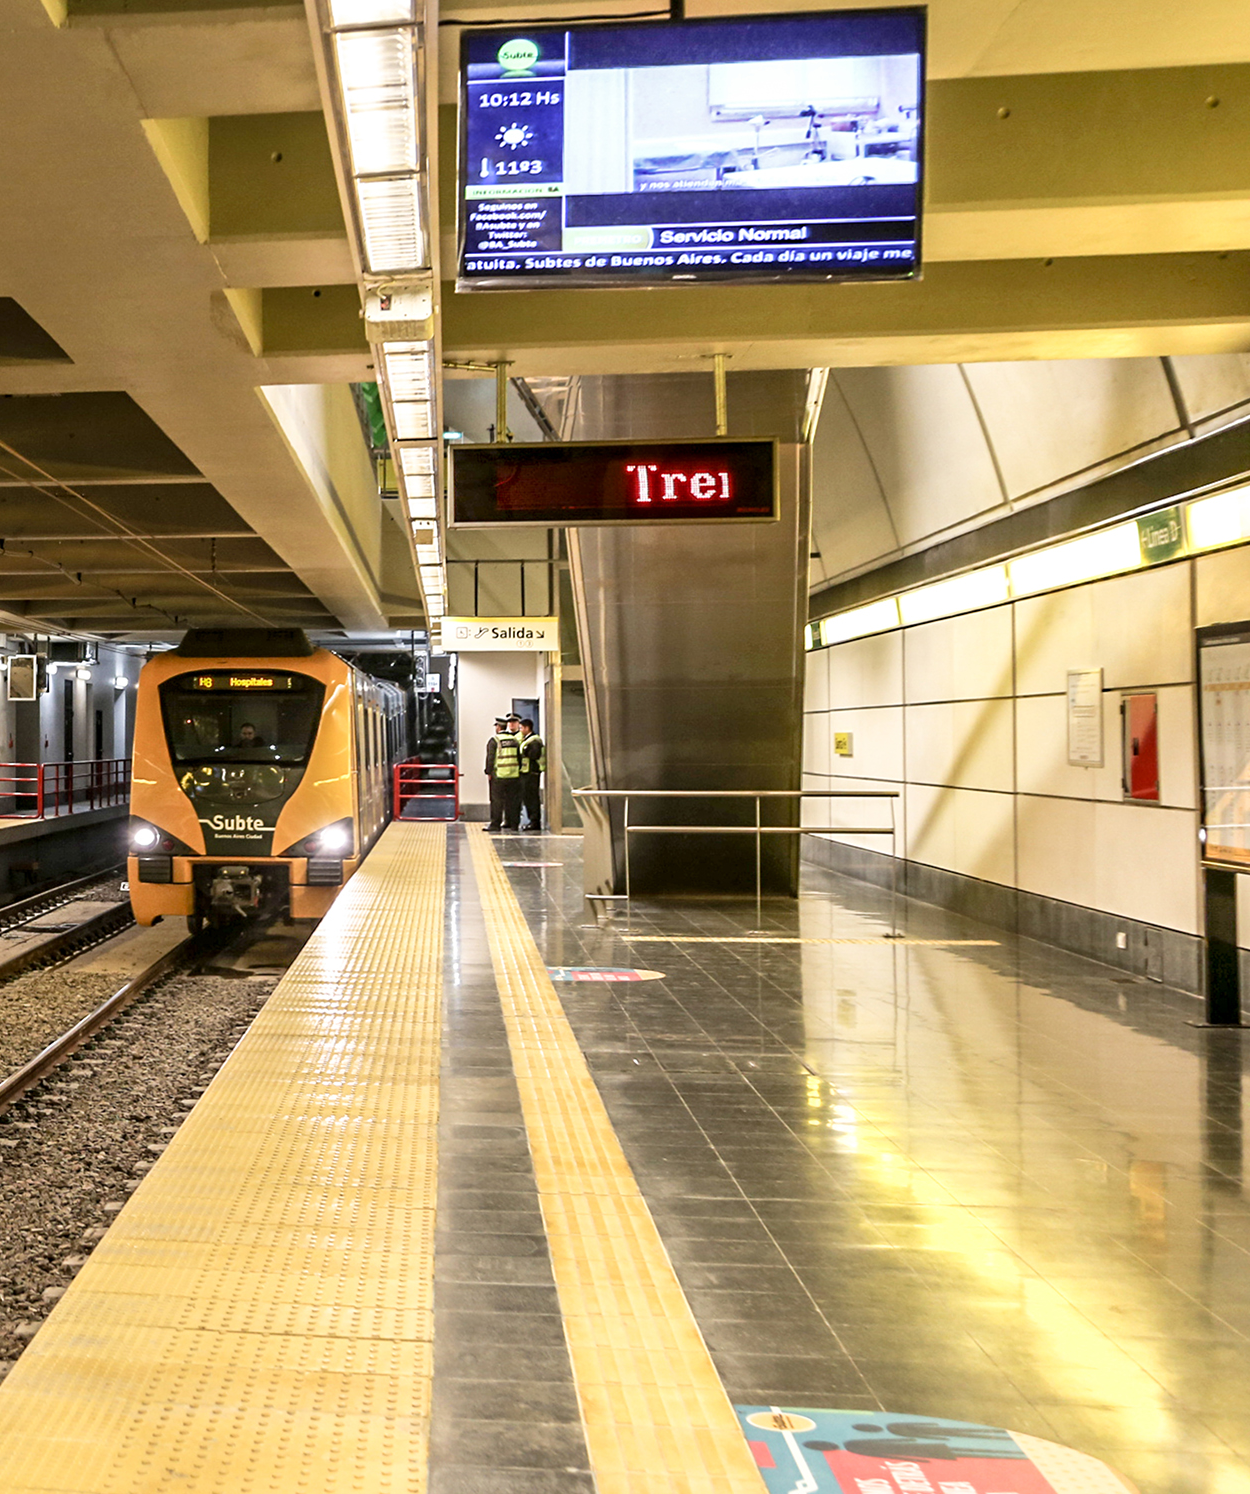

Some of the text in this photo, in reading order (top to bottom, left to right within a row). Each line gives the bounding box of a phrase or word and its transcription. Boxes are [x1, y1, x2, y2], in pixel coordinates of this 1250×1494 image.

[479, 91, 560, 108] 10:12 Hs
[470, 210, 547, 221] Facebook.com/
[518, 222, 526, 230] y
[659, 226, 807, 244] Servicio Normal
[525, 256, 581, 270] Subtes
[585, 256, 607, 268] de
[610, 254, 674, 267] Buenos
[677, 252, 727, 265] Aires.
[730, 251, 775, 264] Cada
[778, 248, 805, 262] día
[809, 250, 833, 262] un
[837, 248, 879, 263] viaje
[492, 627, 533, 639] Salida
[230, 677, 273, 688] Hospitales
[213, 814, 264, 831] Subte
